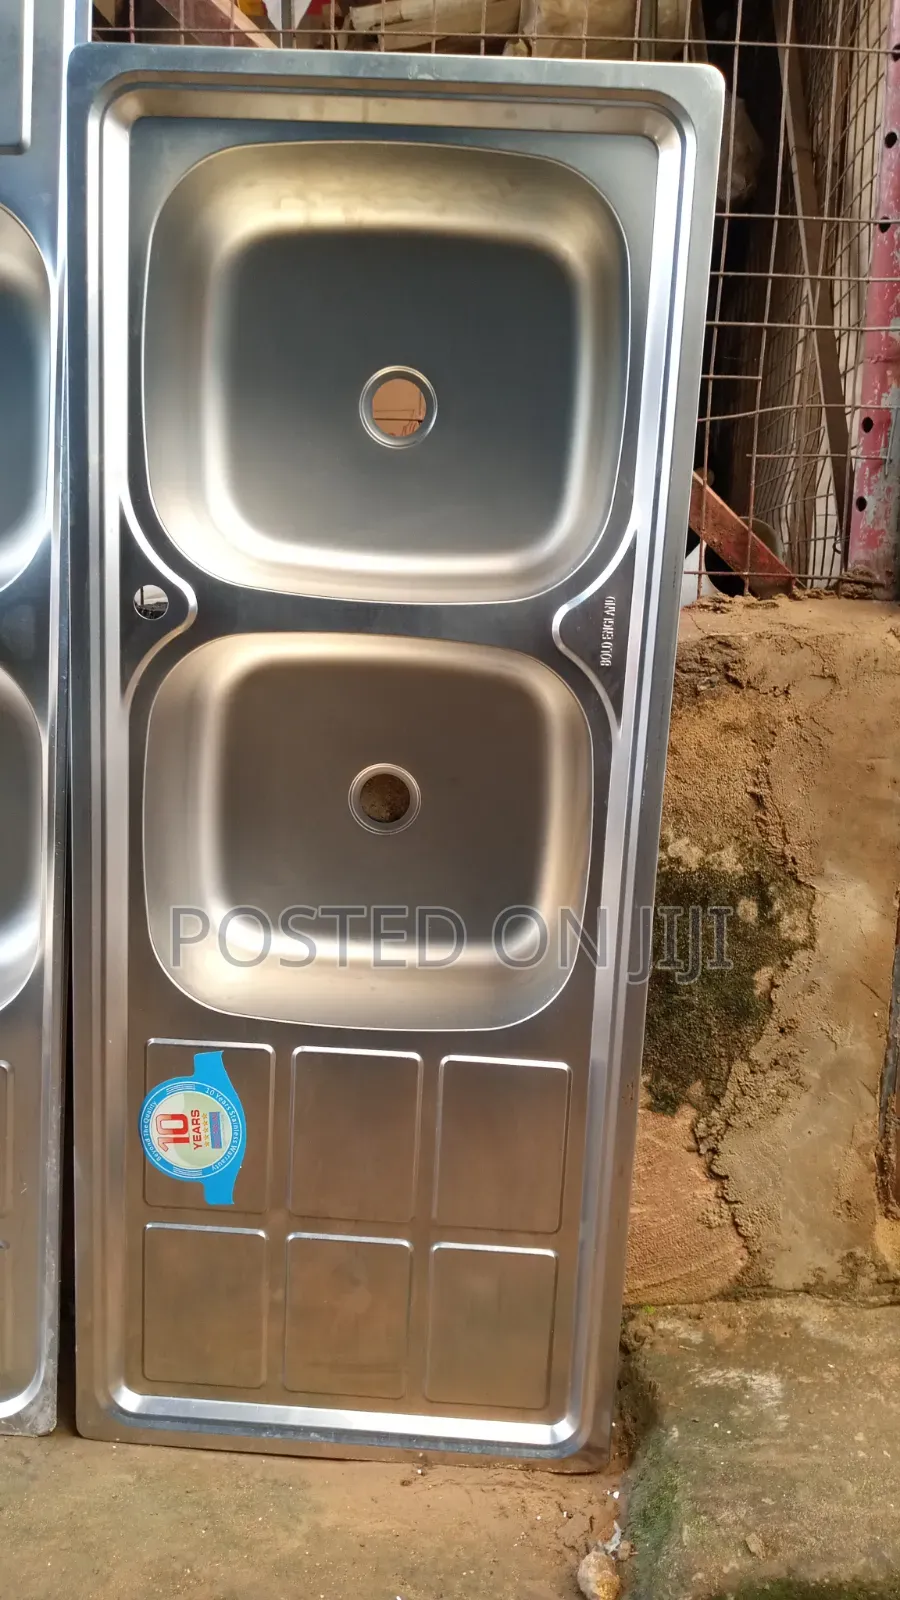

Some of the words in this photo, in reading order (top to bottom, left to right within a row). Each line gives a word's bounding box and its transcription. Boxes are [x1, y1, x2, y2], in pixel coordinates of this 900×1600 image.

[602, 596, 616, 640] ENGLAND
[600, 641, 613, 667] BOLD
[143, 1101, 158, 1123] Quality
[191, 1109, 203, 1150] YEARS
[205, 1087, 215, 1096] 10
[215, 1092, 231, 1111] Years
[228, 1109, 240, 1144] Stainless
[144, 1138, 162, 1162] Beyond
[156, 1113, 190, 1152] 10
